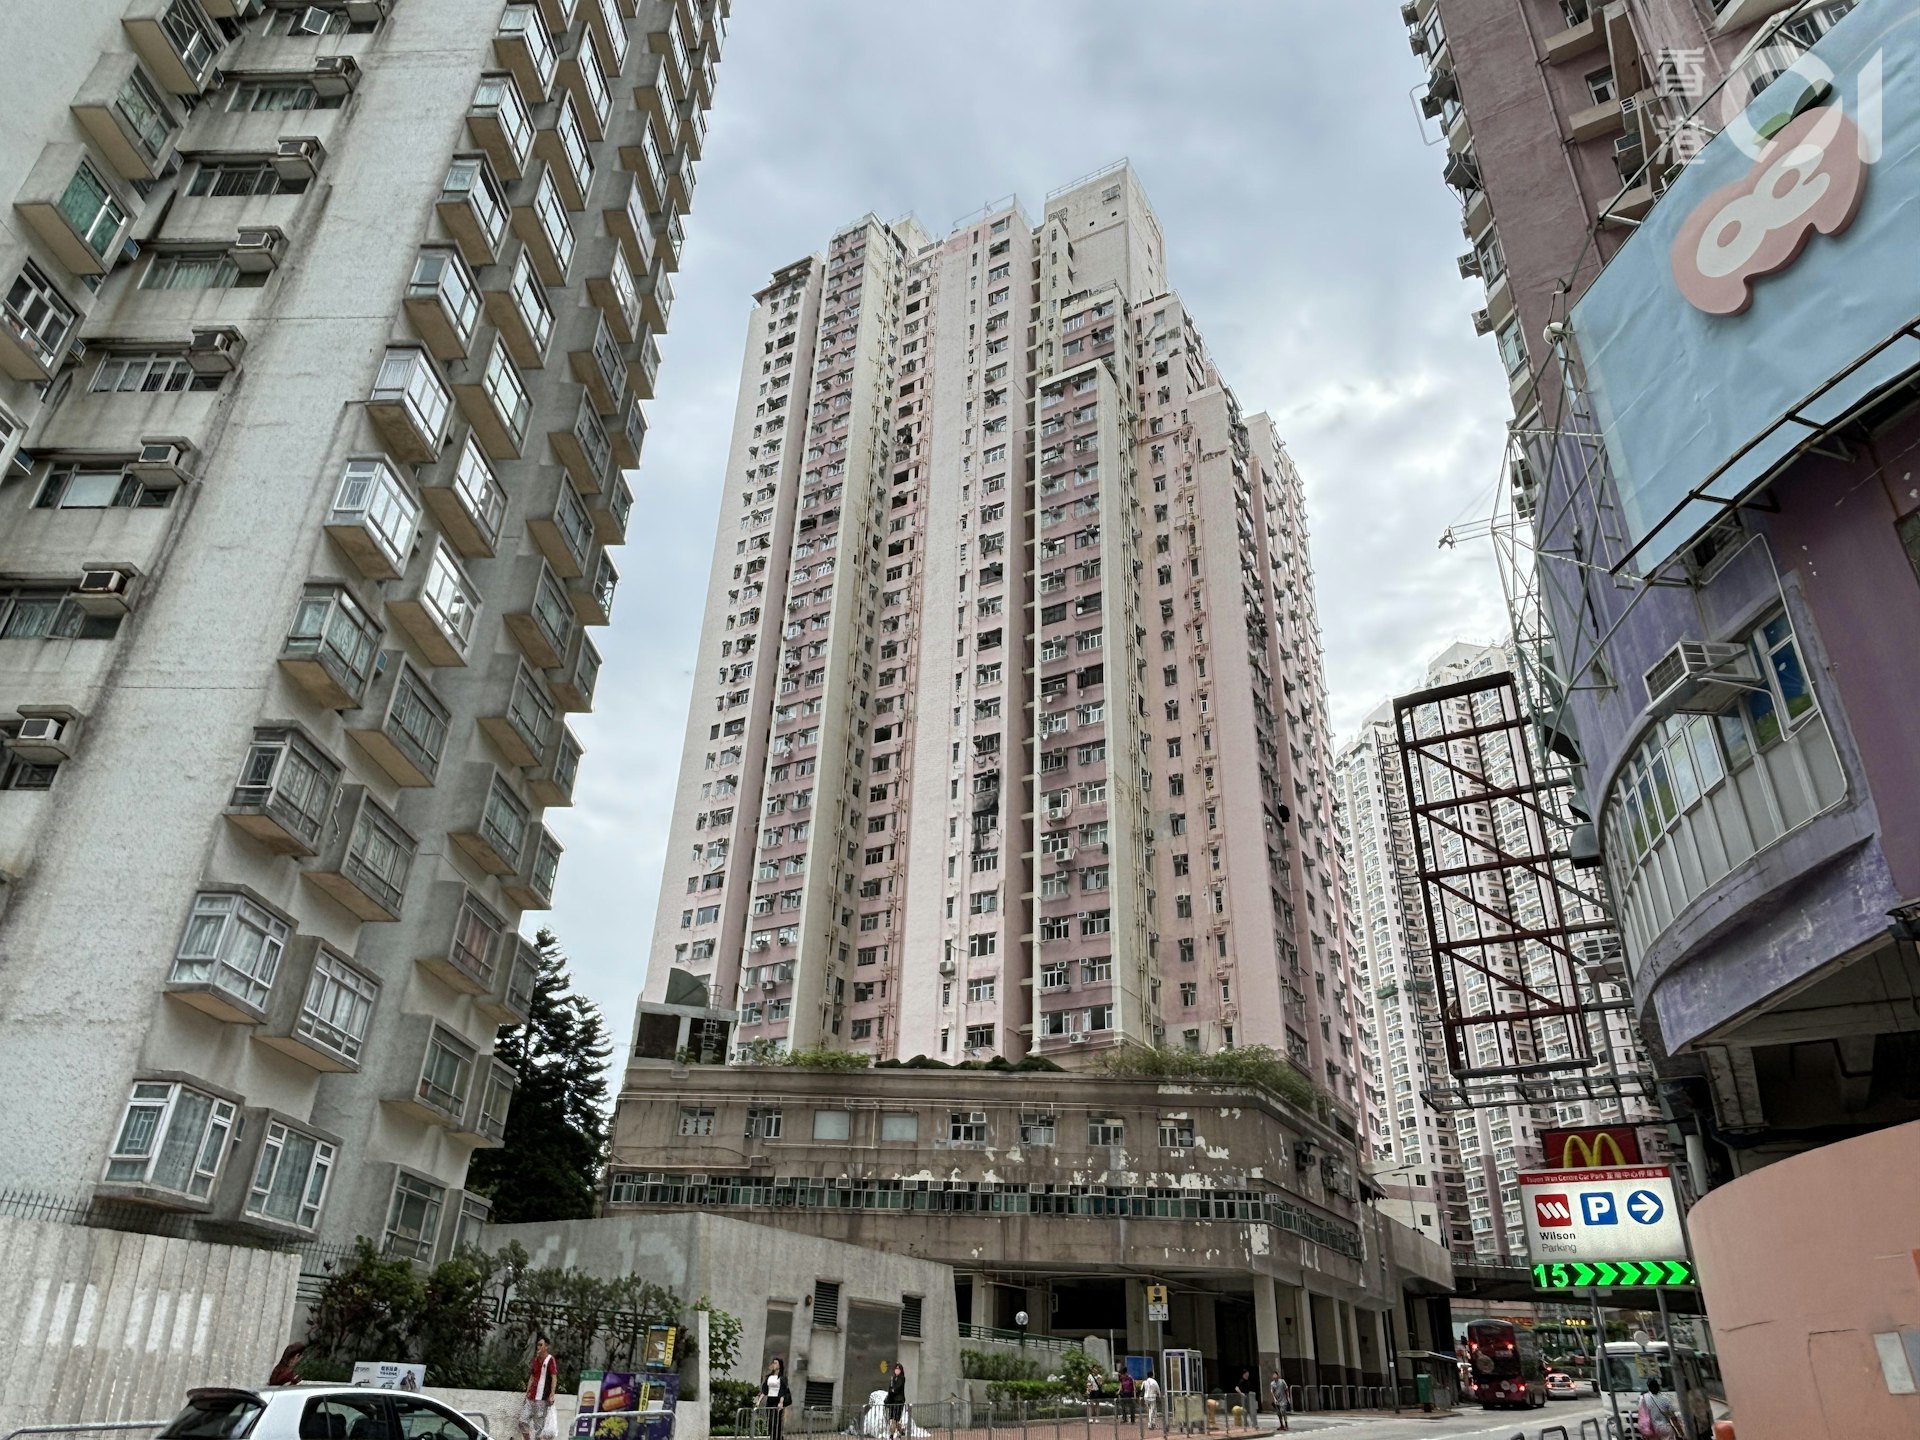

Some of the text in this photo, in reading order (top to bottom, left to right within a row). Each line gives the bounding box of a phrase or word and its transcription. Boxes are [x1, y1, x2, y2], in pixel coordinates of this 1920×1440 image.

[1587, 1196, 1611, 1222] P
[1539, 1231, 1577, 1241] Wilson
[1541, 1242, 1577, 1254] Parking
[1533, 1263, 1569, 1288] 15
